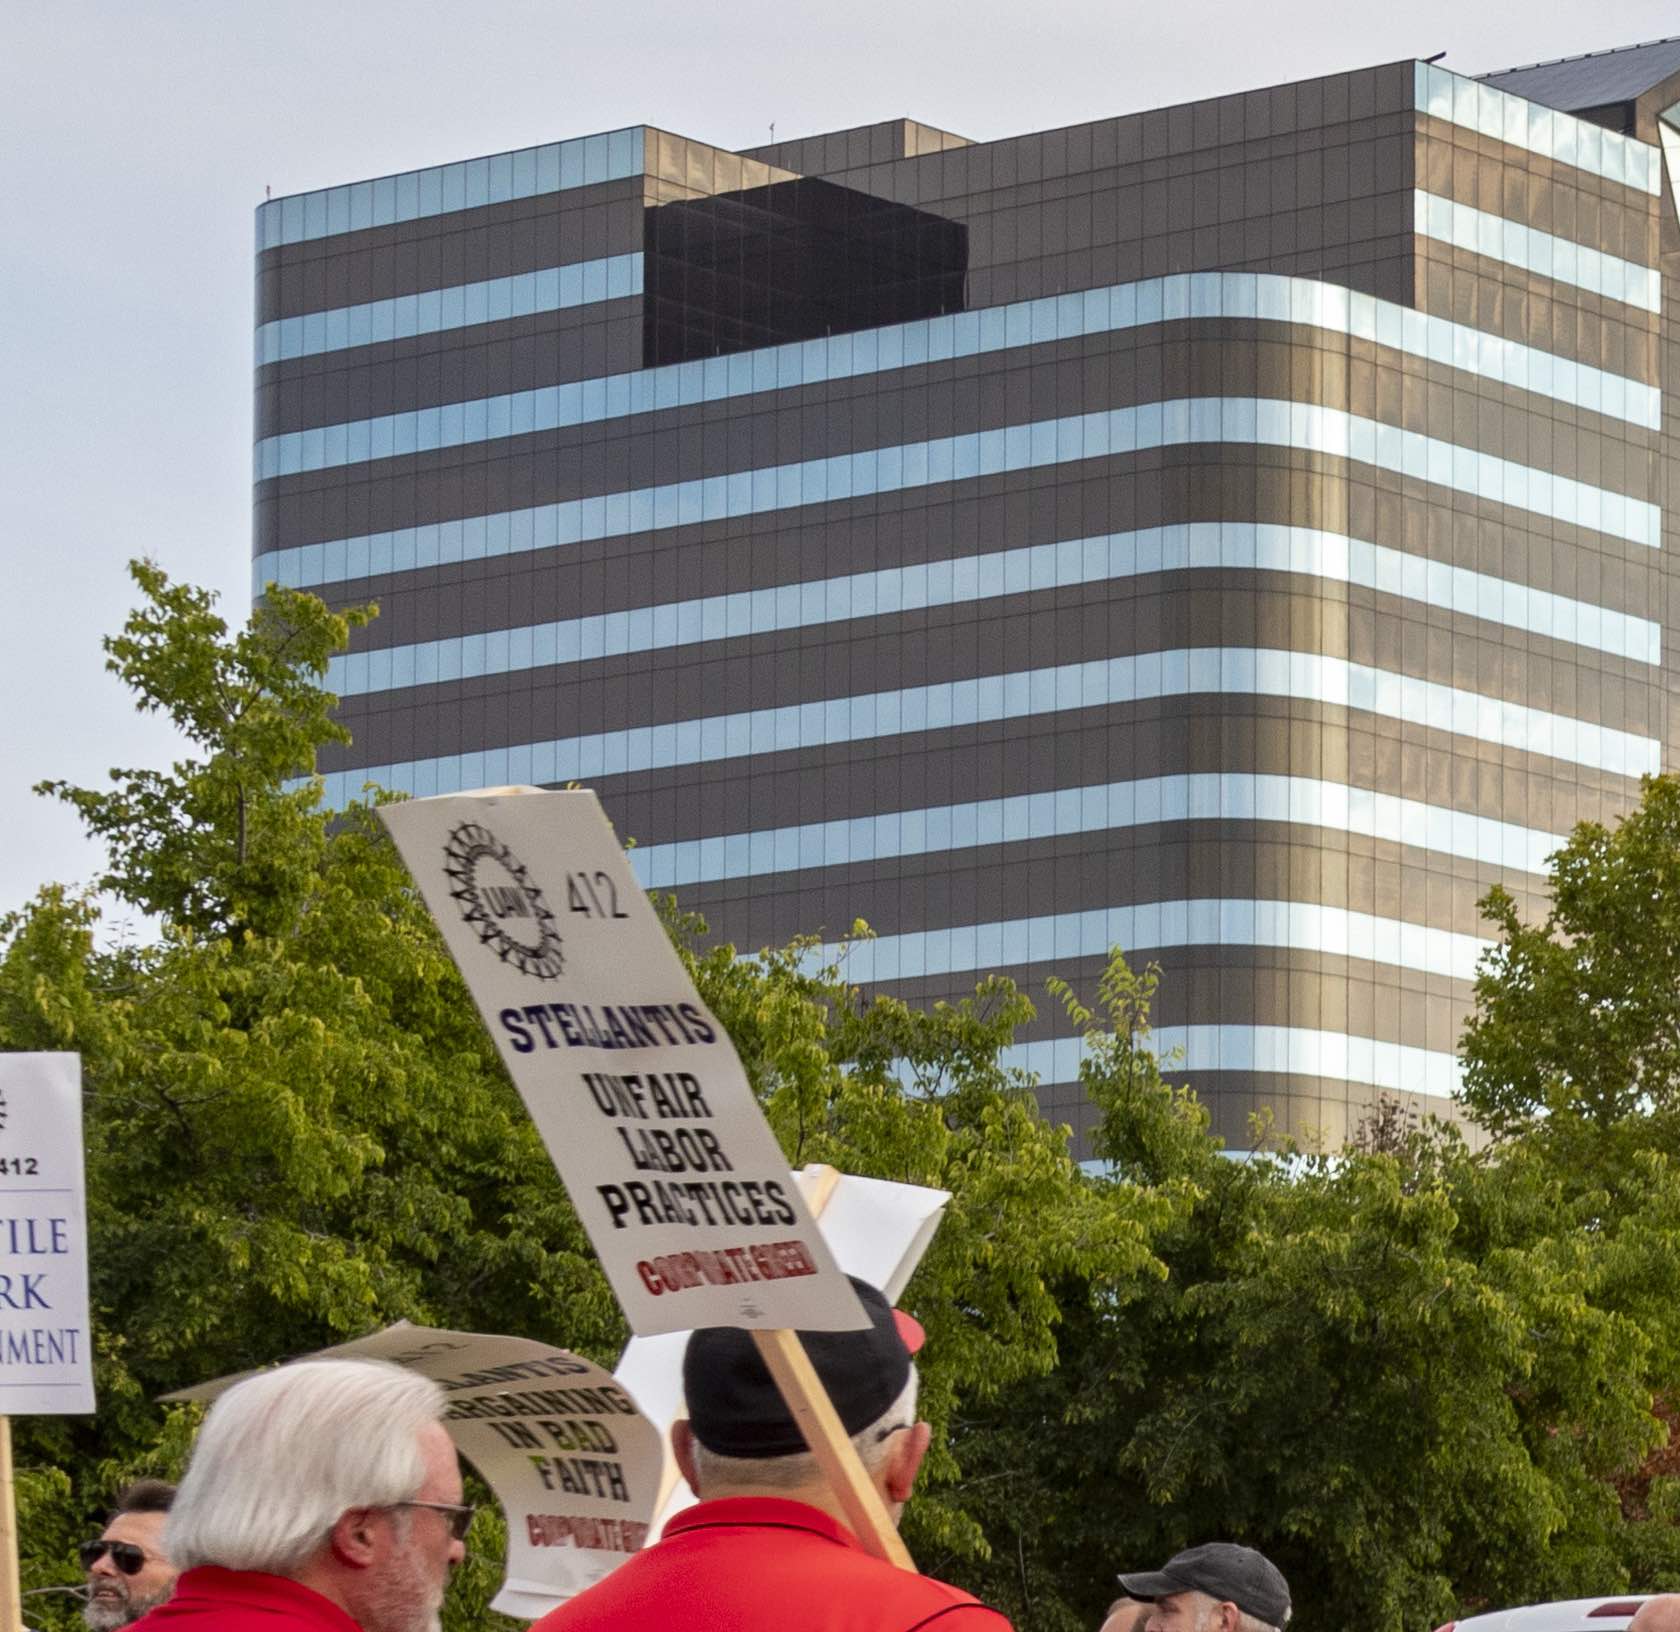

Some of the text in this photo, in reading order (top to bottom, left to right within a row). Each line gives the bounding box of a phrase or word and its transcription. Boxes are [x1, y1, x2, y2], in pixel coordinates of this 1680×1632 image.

[565, 872, 630, 919] 412
[500, 1002, 716, 1053] STELLANTIS
[581, 1072, 713, 1119] UNFAIR
[617, 1125, 734, 1173] LABOR
[595, 1179, 797, 1229] PRACTICES
[487, 1420, 618, 1453] IN BAD
[528, 1455, 630, 1502] FAITH
